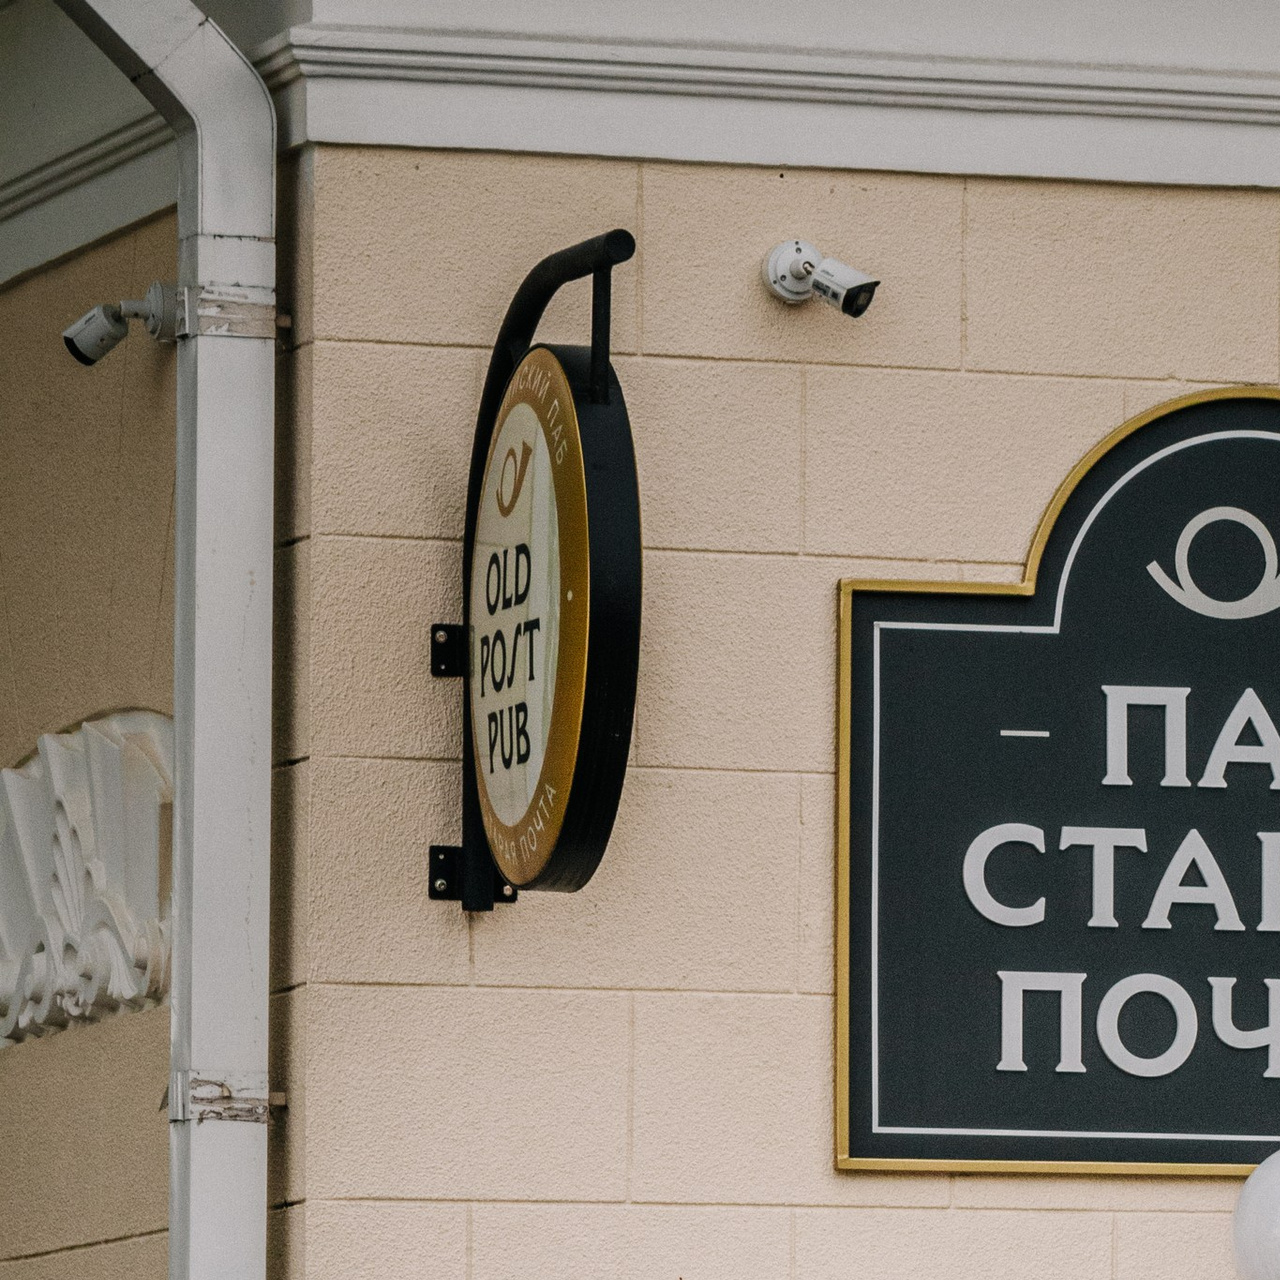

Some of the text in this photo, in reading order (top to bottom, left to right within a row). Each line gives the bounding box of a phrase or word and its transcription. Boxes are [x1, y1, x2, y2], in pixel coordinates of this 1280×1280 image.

[485, 542, 532, 617] OLD
[480, 618, 541, 698] POST
[487, 701, 531, 774] PUB
[520, 783, 557, 863] ПОЧТА
